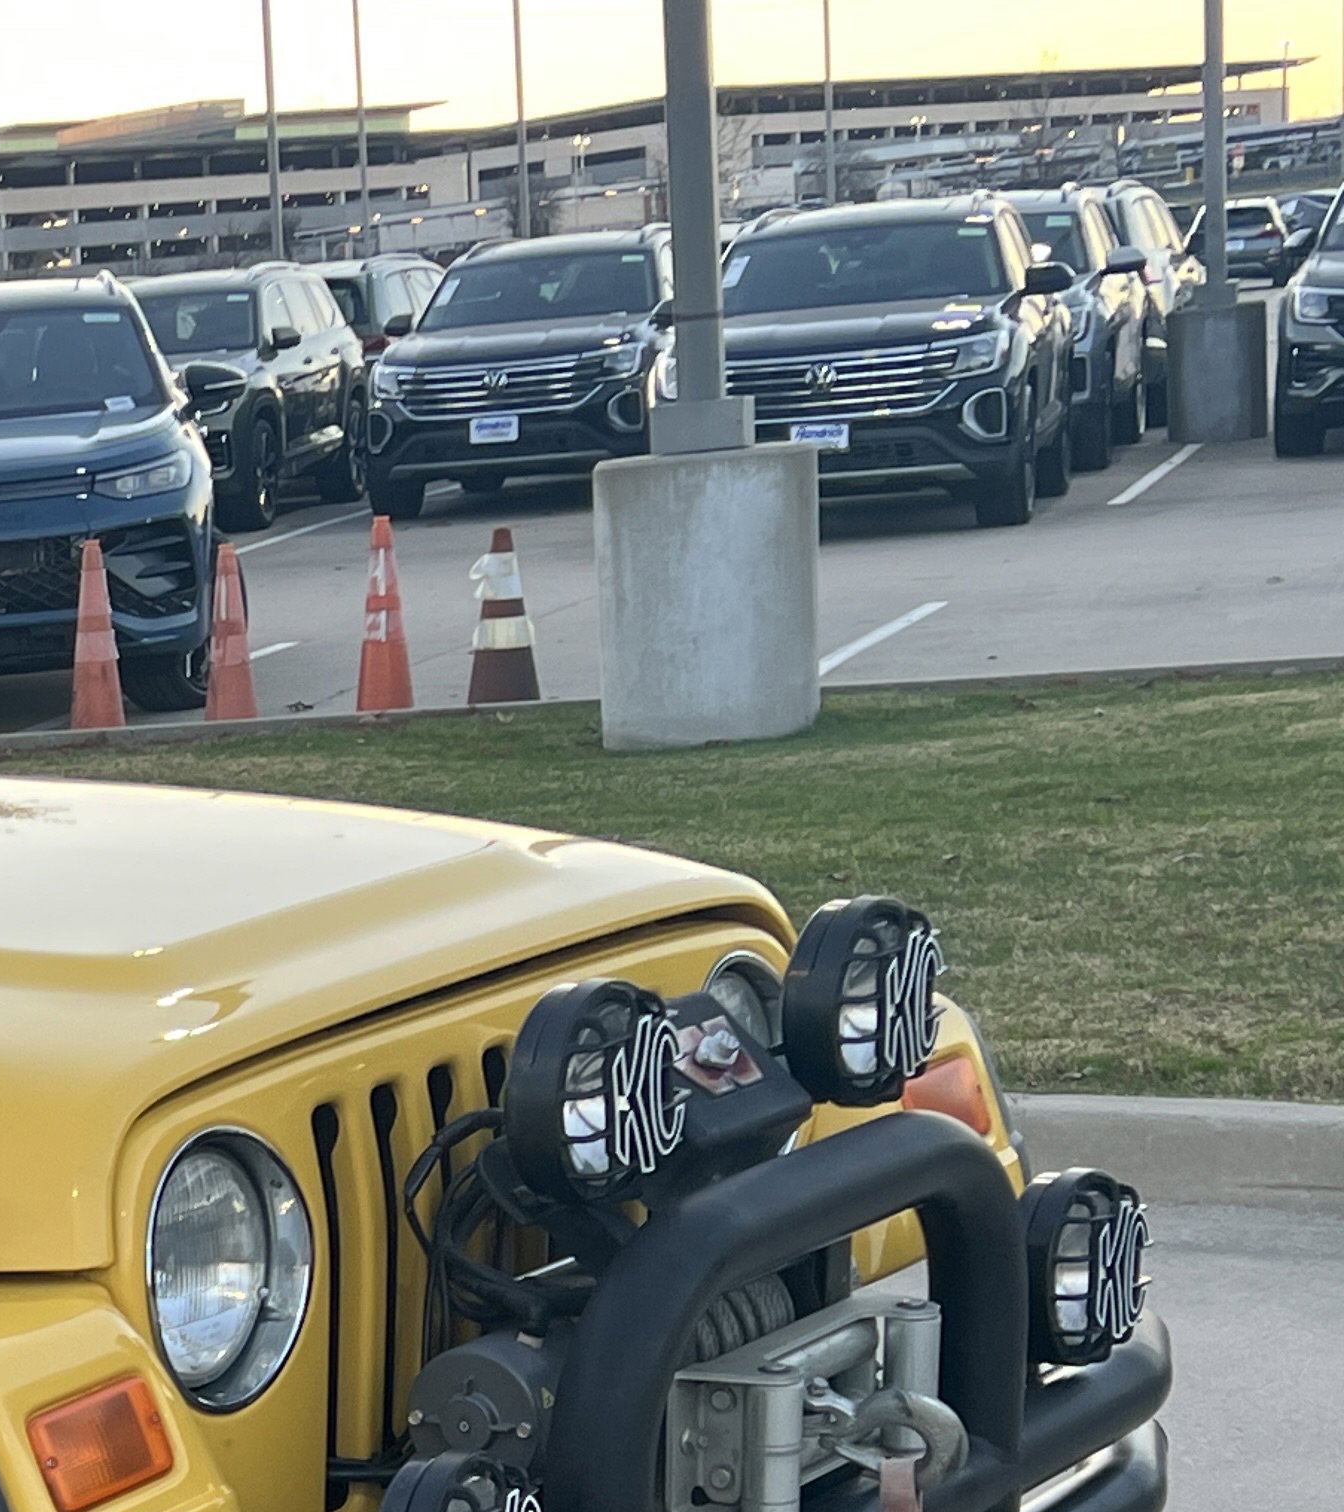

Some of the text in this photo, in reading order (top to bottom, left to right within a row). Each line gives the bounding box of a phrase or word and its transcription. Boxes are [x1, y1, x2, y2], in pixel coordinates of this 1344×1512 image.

[884, 929, 947, 1076] KC
[612, 1014, 688, 1173] KC
[1095, 1199, 1153, 1338] KC
